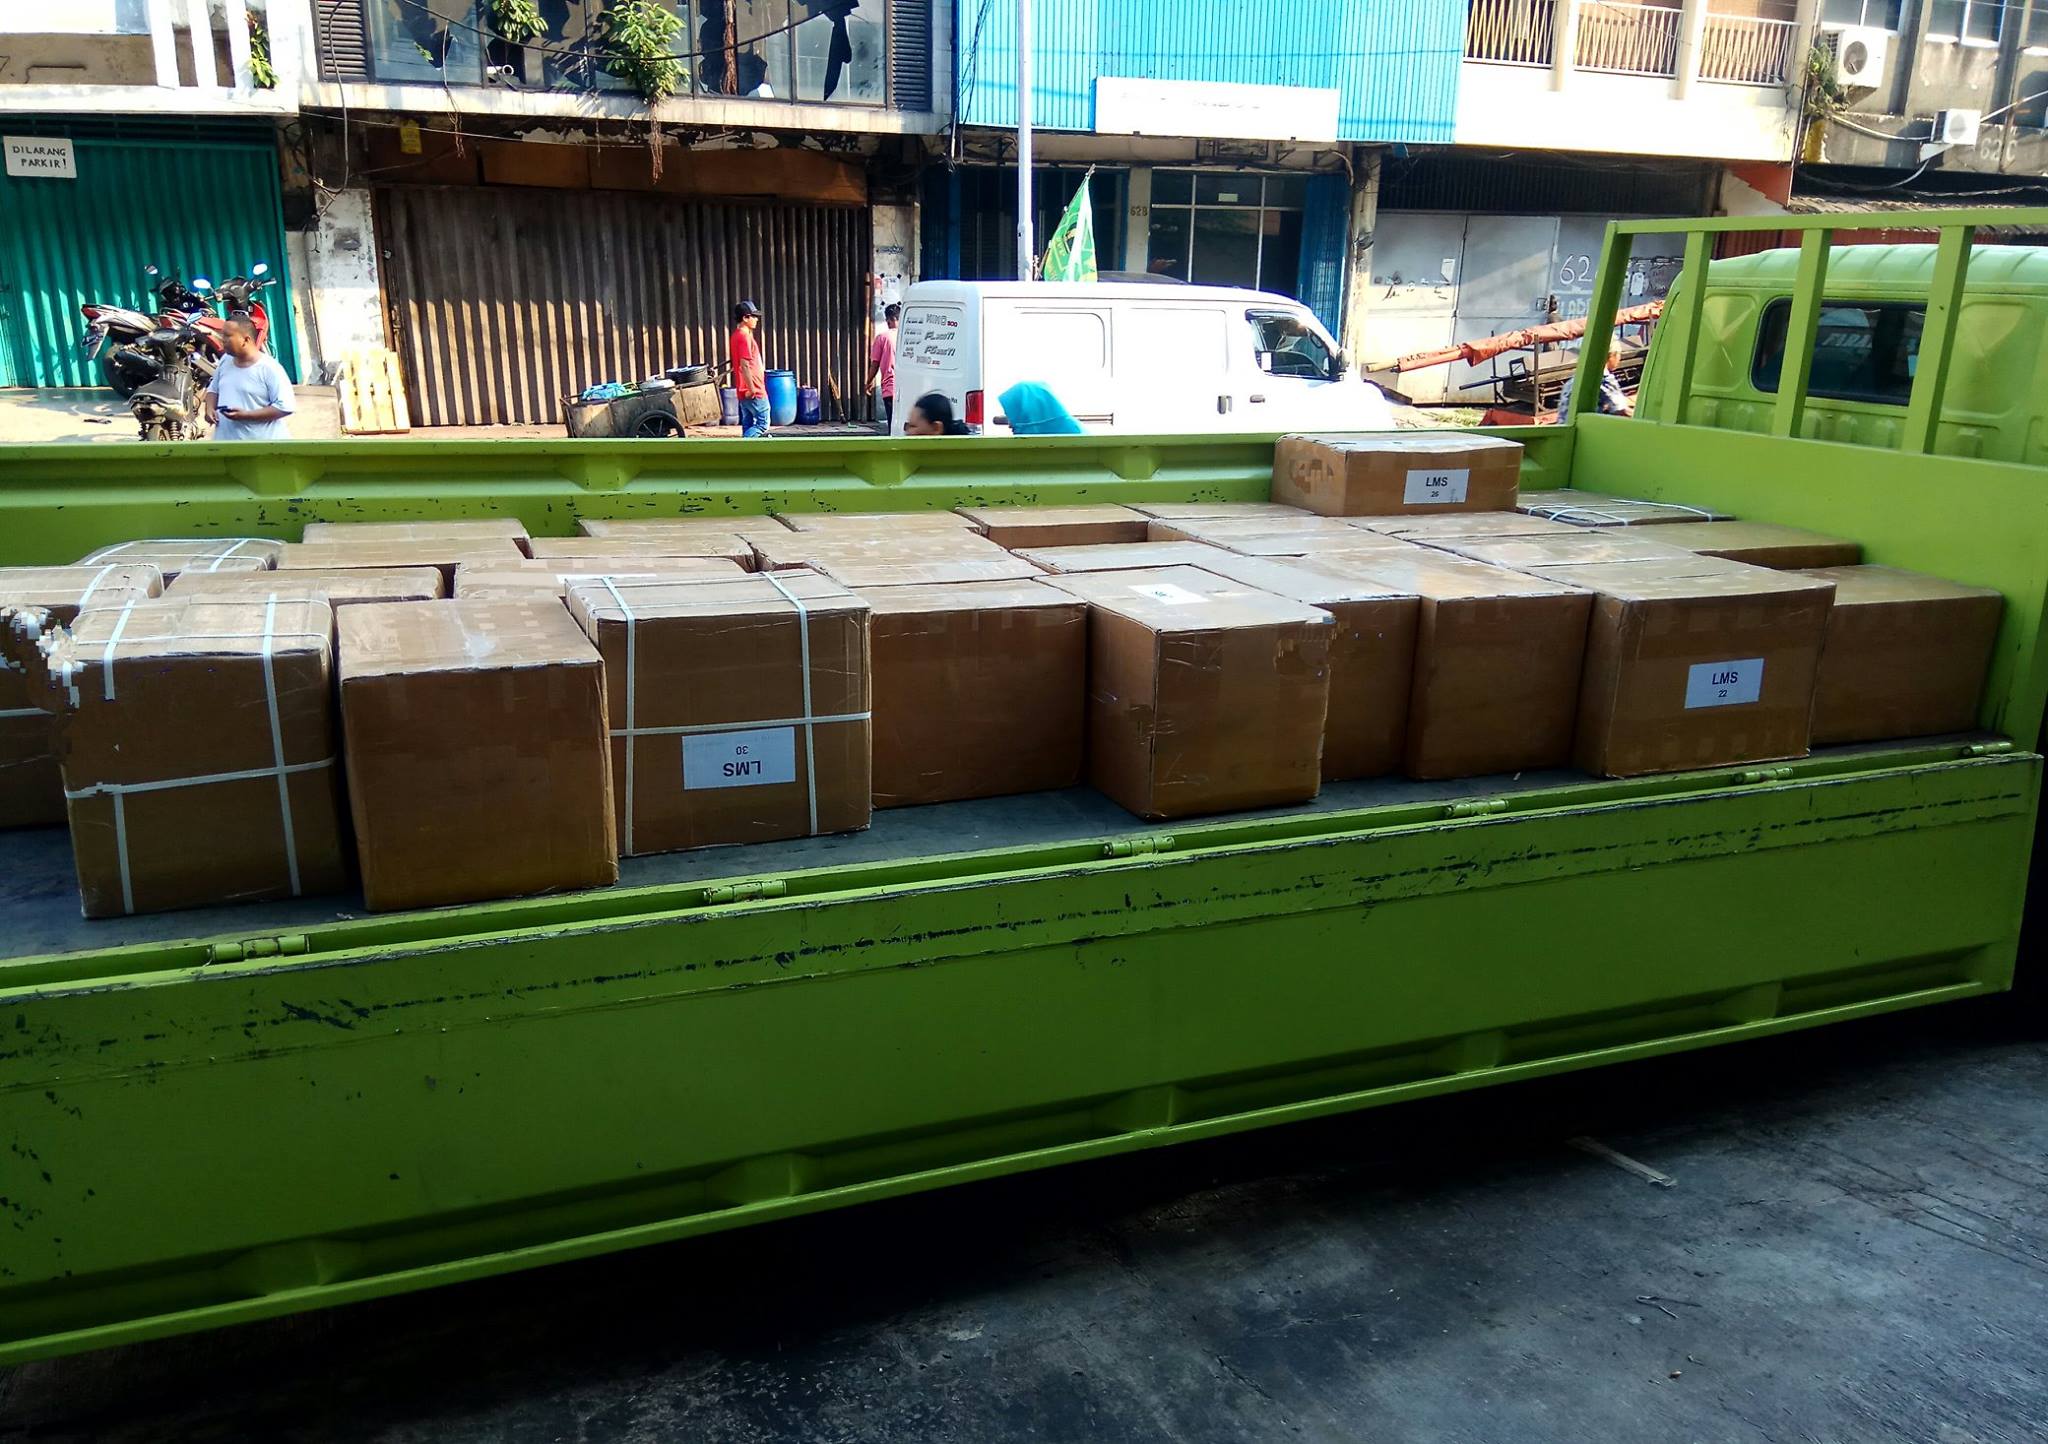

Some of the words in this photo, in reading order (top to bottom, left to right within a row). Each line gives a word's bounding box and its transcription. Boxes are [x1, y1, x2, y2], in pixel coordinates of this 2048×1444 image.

[12, 145, 67, 157] DILARANG
[20, 158, 67, 169] PARKIR!
[1560, 255, 1598, 285] 62
[1425, 476, 1448, 487] LMS
[1712, 671, 1739, 685] LMS
[1718, 689, 1728, 698] 22
[735, 745, 749, 756] 30
[722, 760, 762, 777] LMS
